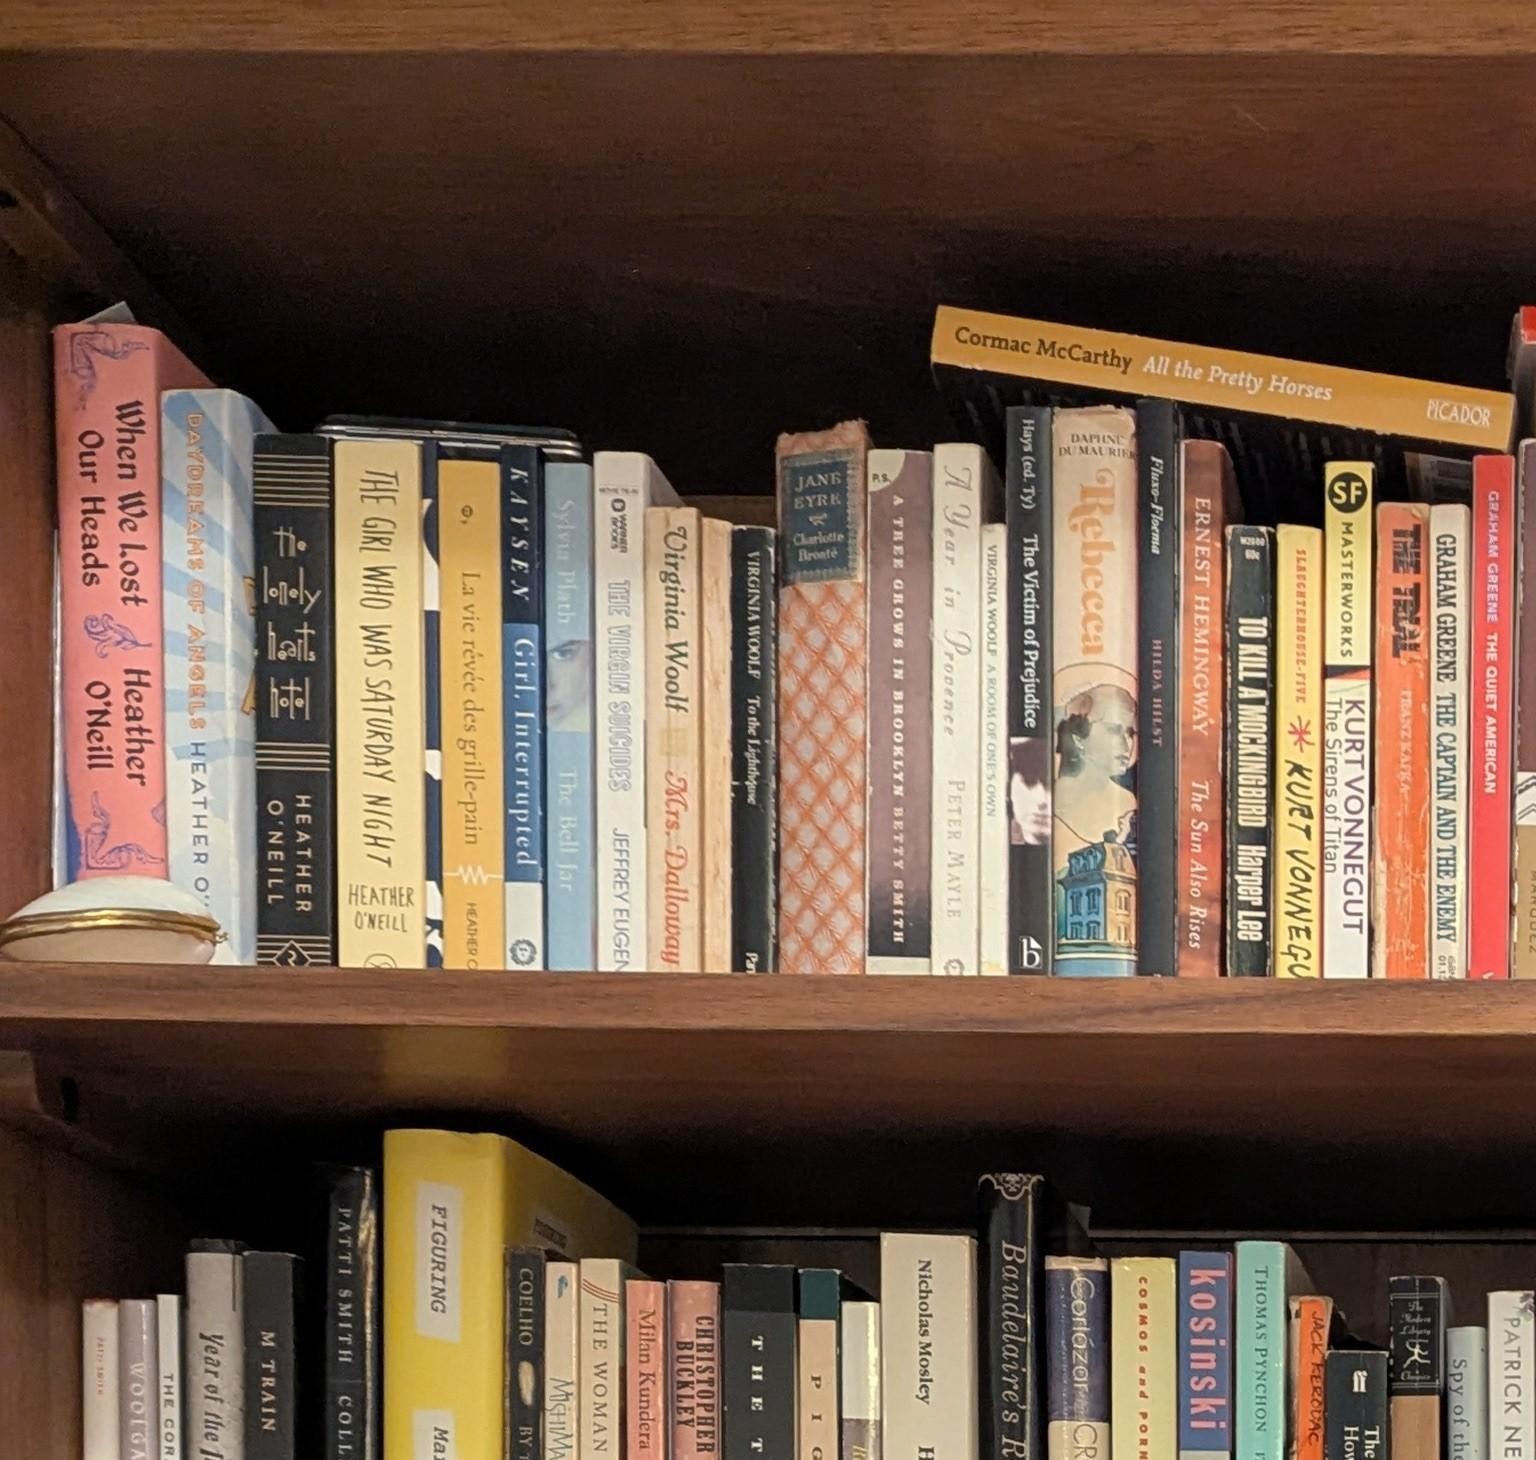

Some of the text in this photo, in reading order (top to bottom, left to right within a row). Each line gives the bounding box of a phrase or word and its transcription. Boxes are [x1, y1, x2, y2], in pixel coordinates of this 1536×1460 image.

[955, 327, 1133, 374] Cormac McCarthy
[1142, 356, 1333, 402] All the Pretty Horses
[1425, 400, 1492, 428] PICADOR
[77, 430, 104, 587] Our Heads
[114, 400, 147, 606] When We Lost
[1331, 481, 1363, 503] SF
[659, 526, 689, 713] Virginia Woolf
[1339, 522, 1353, 658] MASTERWORKS
[85, 680, 114, 770] O'Neill
[122, 668, 151, 786] Heather
[358, 470, 399, 867] THE GIRL WHO WAS SATURDAY NIGHT
[660, 770, 689, 967] Mrs. Dalloway
[1341, 699, 1365, 936] KURT VONNEGUT
[348, 885, 415, 908] HEATHER
[354, 911, 408, 933] O'NEILL
[430, 1204, 448, 1315] FIGURING
[262, 1330, 276, 1432] M TRAIN
[637, 1308, 656, 1451] Milan Kundera
[915, 1258, 933, 1405] Nicholas Mosley
[1188, 1267, 1227, 1431] kosinski
[1363, 1425, 1379, 1456] The
